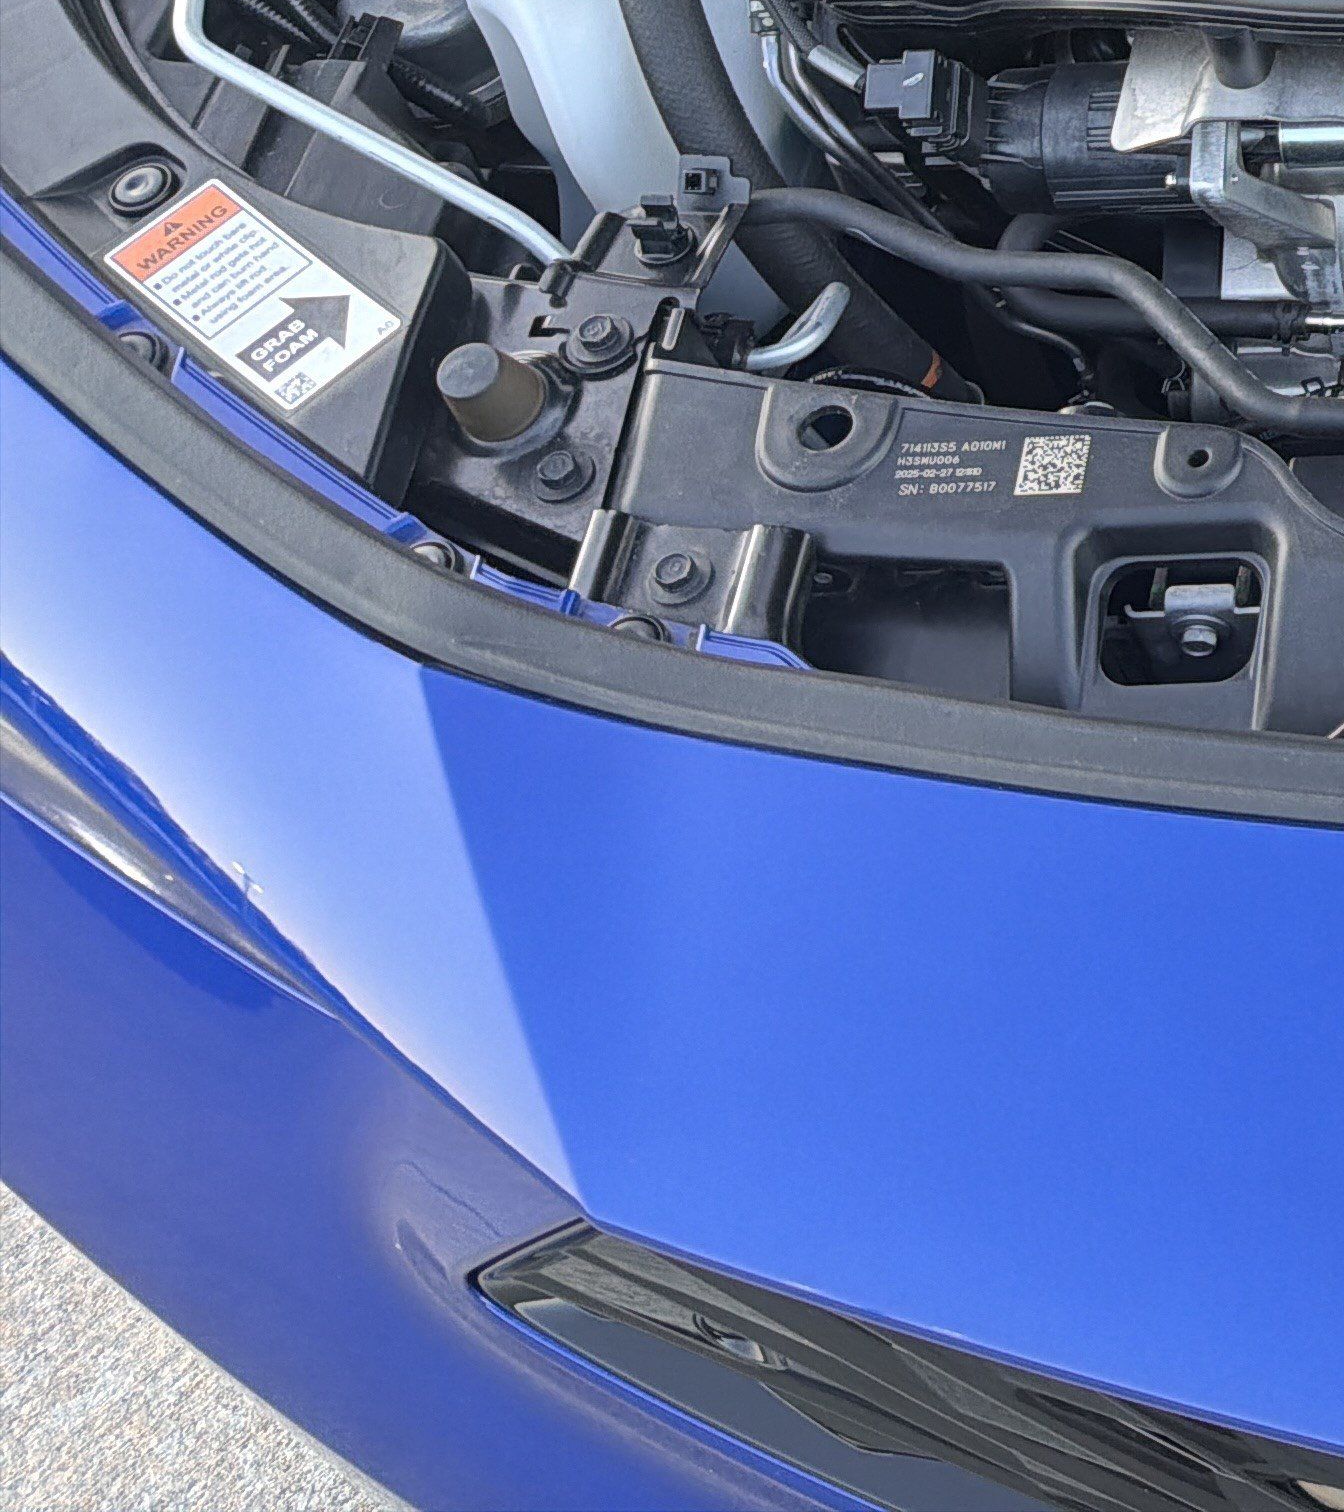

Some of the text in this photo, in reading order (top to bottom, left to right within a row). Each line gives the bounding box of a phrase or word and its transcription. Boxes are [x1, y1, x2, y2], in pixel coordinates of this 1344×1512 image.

[136, 205, 228, 270] WARNING
[250, 319, 306, 362] GRAB
[262, 329, 319, 373] FOAM
[898, 482, 925, 496] SN:
